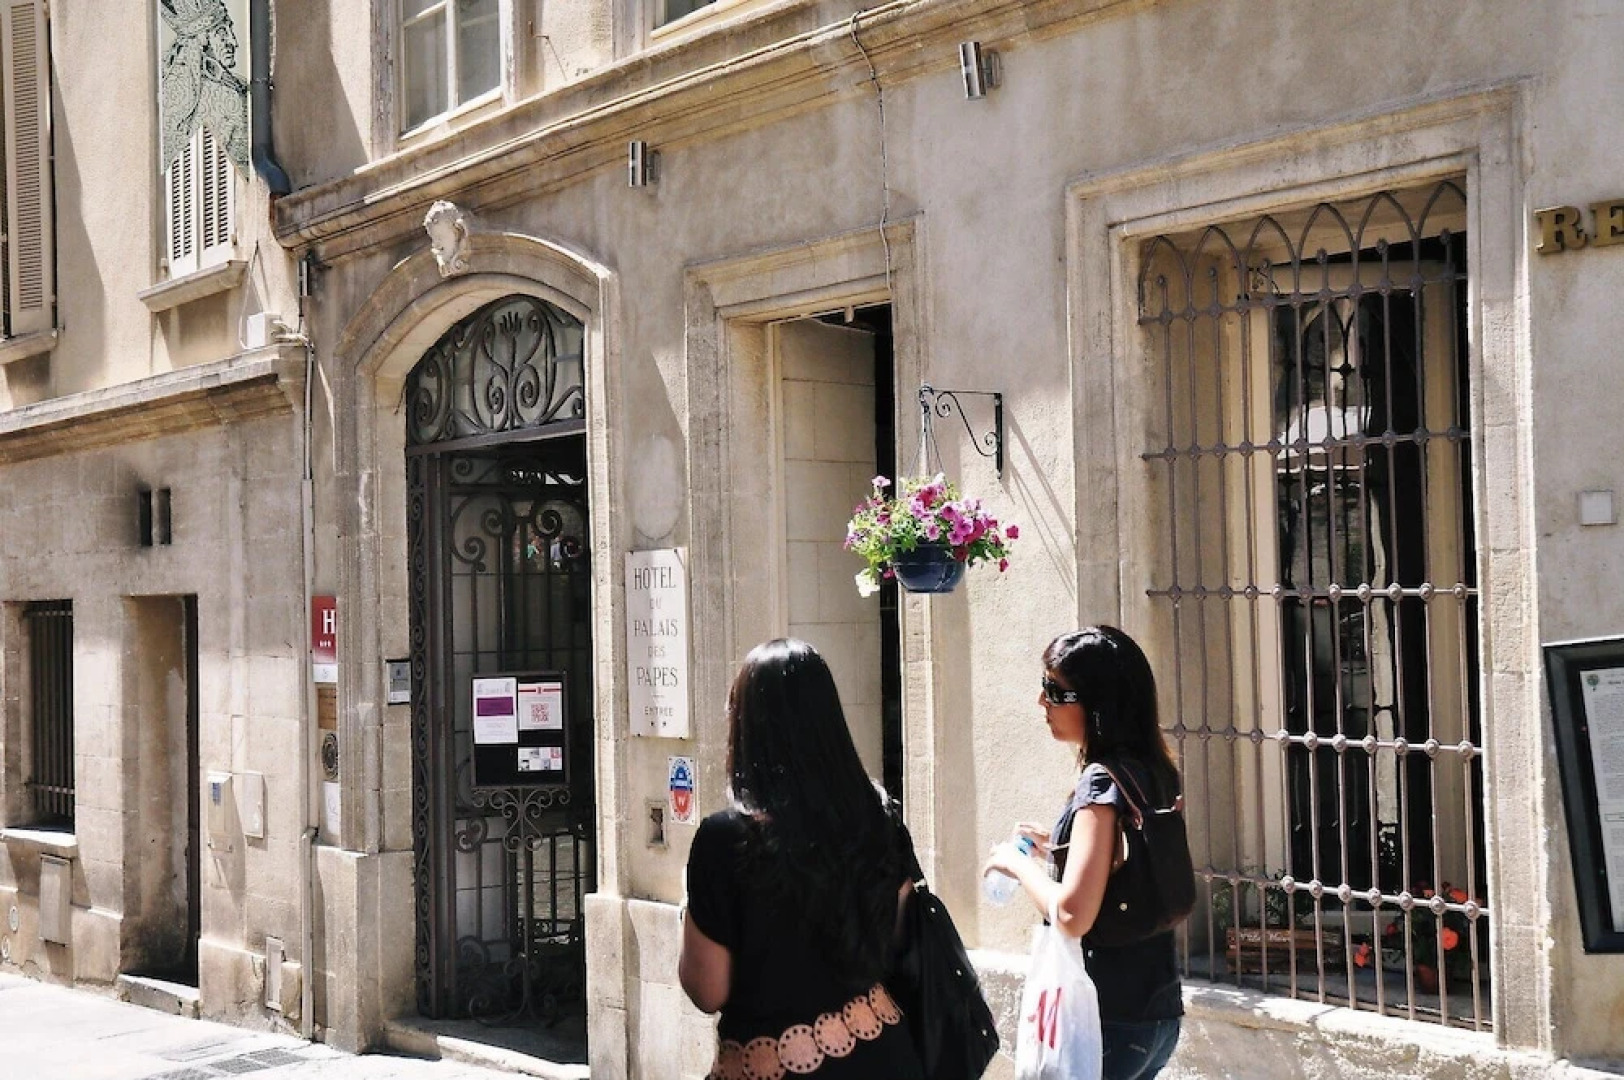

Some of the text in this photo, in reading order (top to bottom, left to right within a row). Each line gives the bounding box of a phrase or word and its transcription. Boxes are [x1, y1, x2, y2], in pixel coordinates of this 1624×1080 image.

[322, 609, 336, 634] H
[633, 618, 678, 637] PALAIS
[636, 666, 678, 687] PAPES
